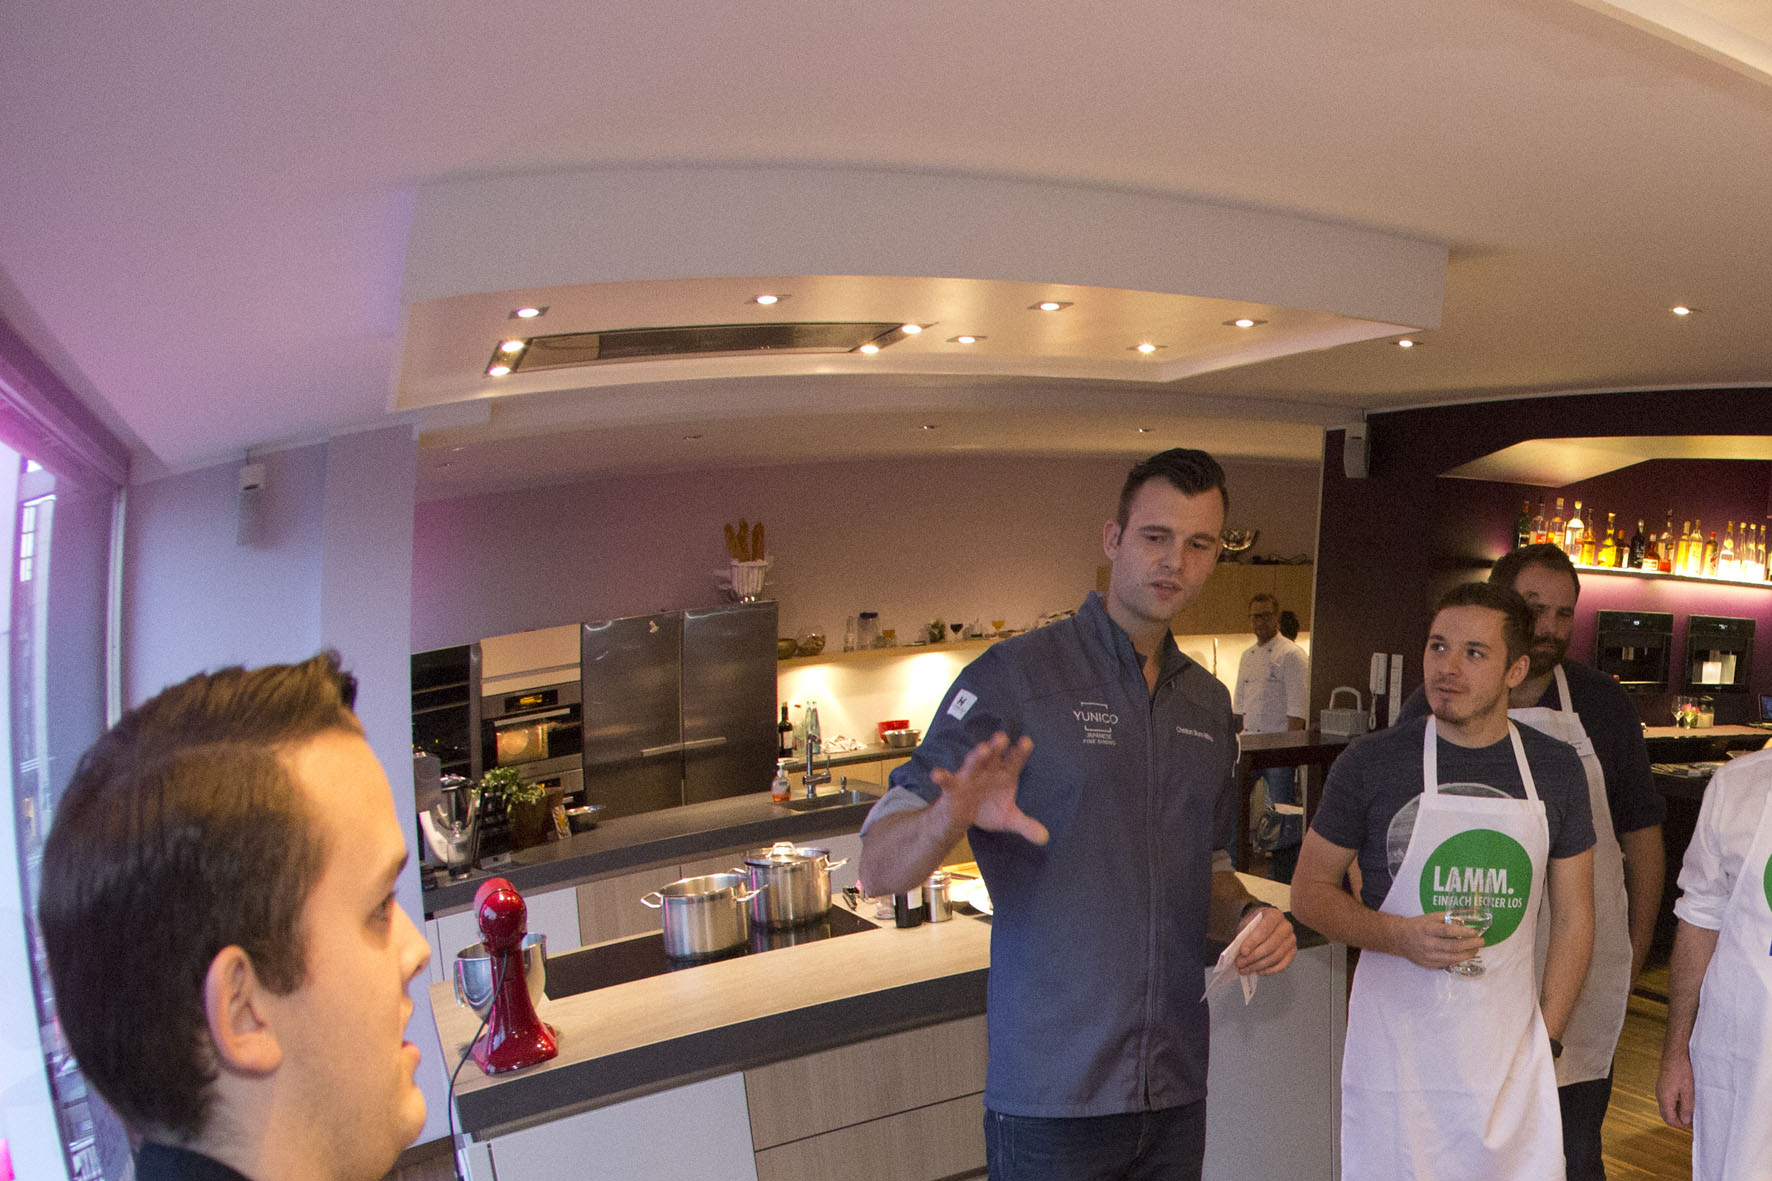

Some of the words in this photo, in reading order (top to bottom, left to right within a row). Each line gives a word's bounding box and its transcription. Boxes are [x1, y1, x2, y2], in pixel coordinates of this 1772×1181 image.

[1072, 709, 1119, 725] YUNICO
[1433, 866, 1514, 895] LAMM.
[1432, 895, 1472, 906] EINFACH
[1474, 896, 1505, 908] LECKER
[1508, 898, 1522, 908] LOS
